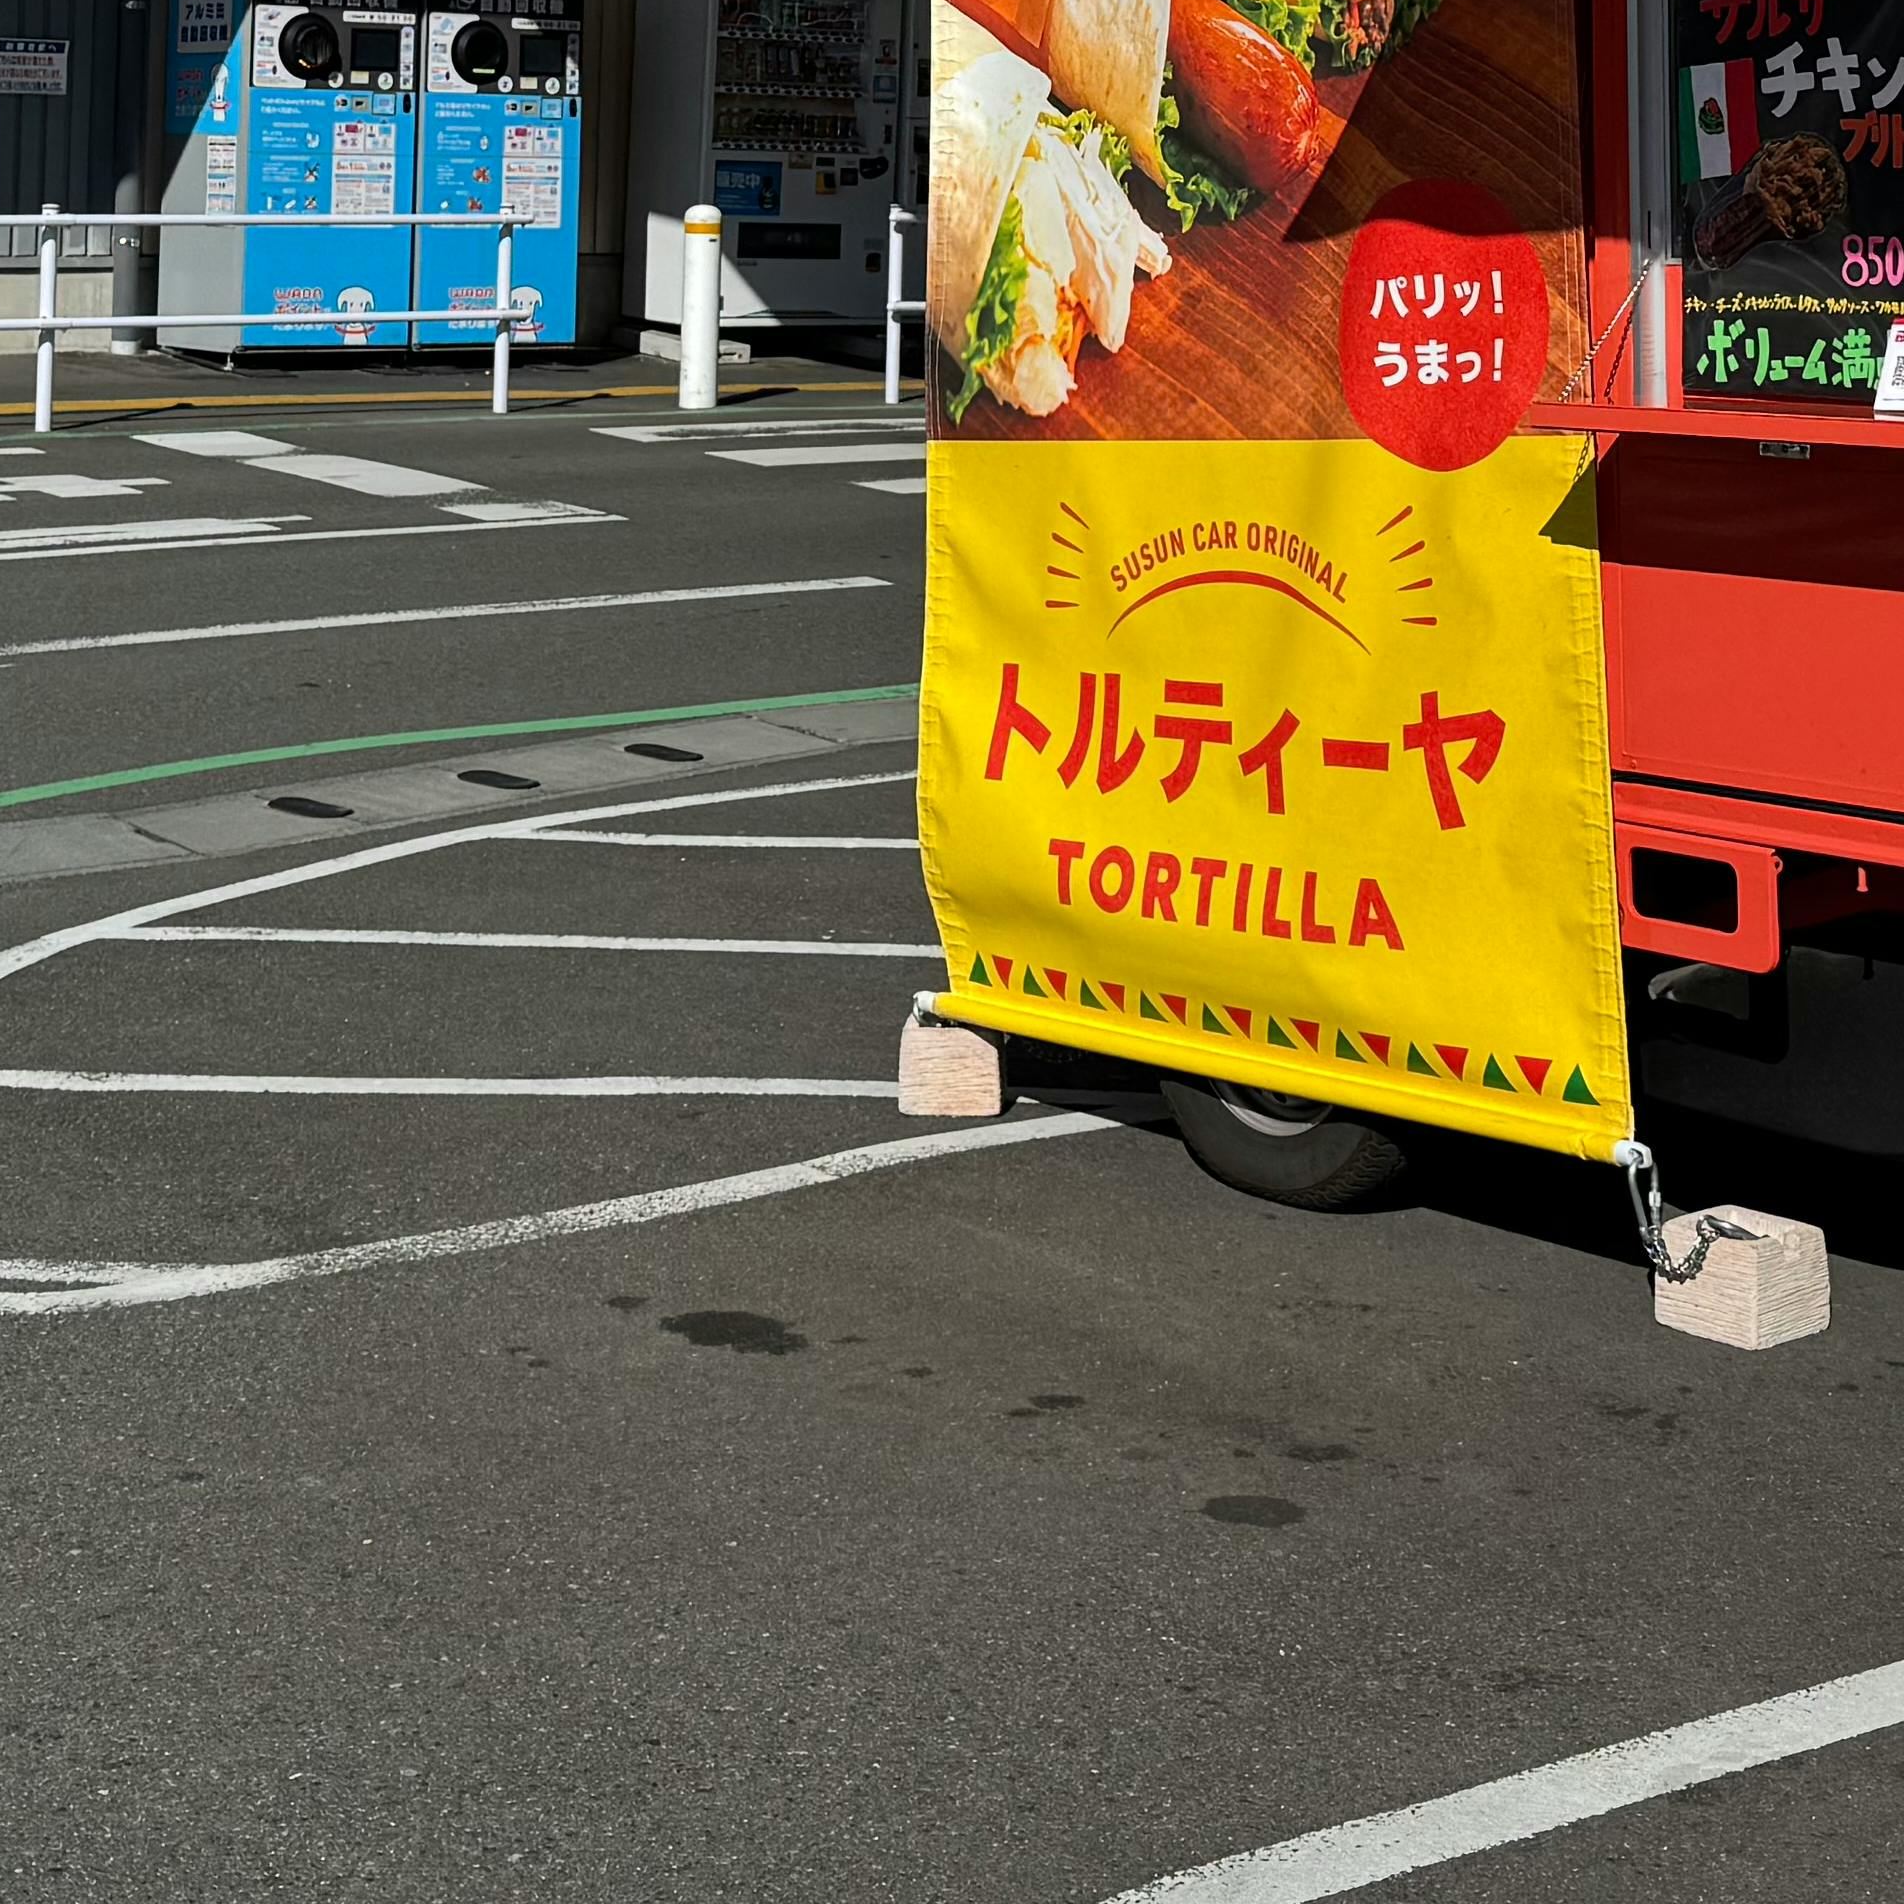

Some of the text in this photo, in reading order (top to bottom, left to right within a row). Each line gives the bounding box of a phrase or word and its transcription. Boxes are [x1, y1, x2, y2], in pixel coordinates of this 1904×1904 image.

[1369, 269, 1504, 321] パリッ!
[1372, 337, 1504, 388] うまっ!
[1696, 316, 1883, 390] ボリューム満
[1108, 519, 1347, 604] SUSUN CAR ORIGINAL
[983, 661, 1507, 831] トルティーヤ
[1047, 838, 1406, 952] TORTILLA
